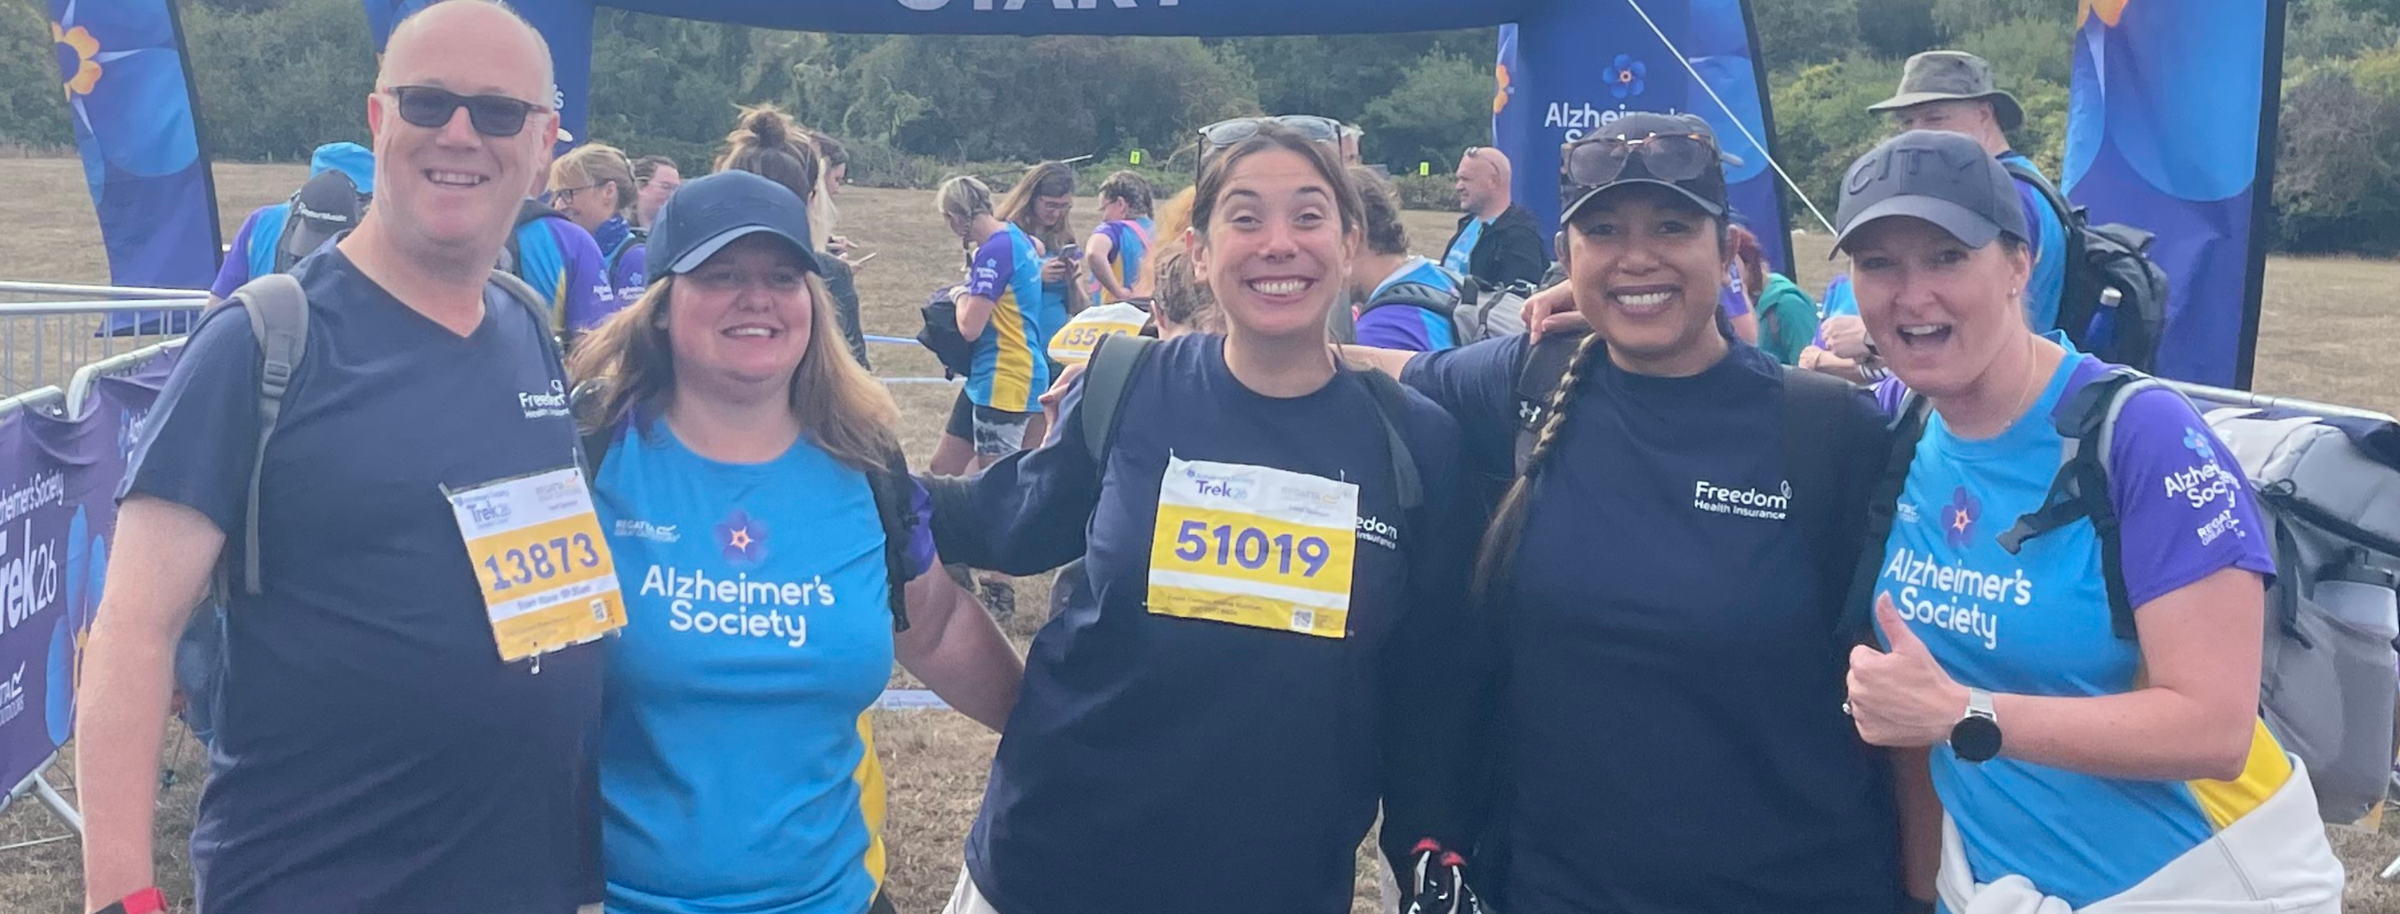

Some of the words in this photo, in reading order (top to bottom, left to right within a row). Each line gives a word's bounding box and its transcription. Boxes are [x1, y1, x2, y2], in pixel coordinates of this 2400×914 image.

[1849, 147, 1978, 195] CITY
[1061, 327, 1127, 347] 135
[1694, 499, 1731, 514] Health
[1733, 505, 1786, 520] Insurance
[1695, 480, 1787, 510] Freedom
[485, 532, 600, 591] 13873
[1175, 520, 1330, 578] 51019
[640, 564, 835, 606] Alzheimer's
[1884, 548, 2032, 606] Alzheimer's
[669, 599, 807, 648] Society
[1898, 586, 1997, 650] Society
